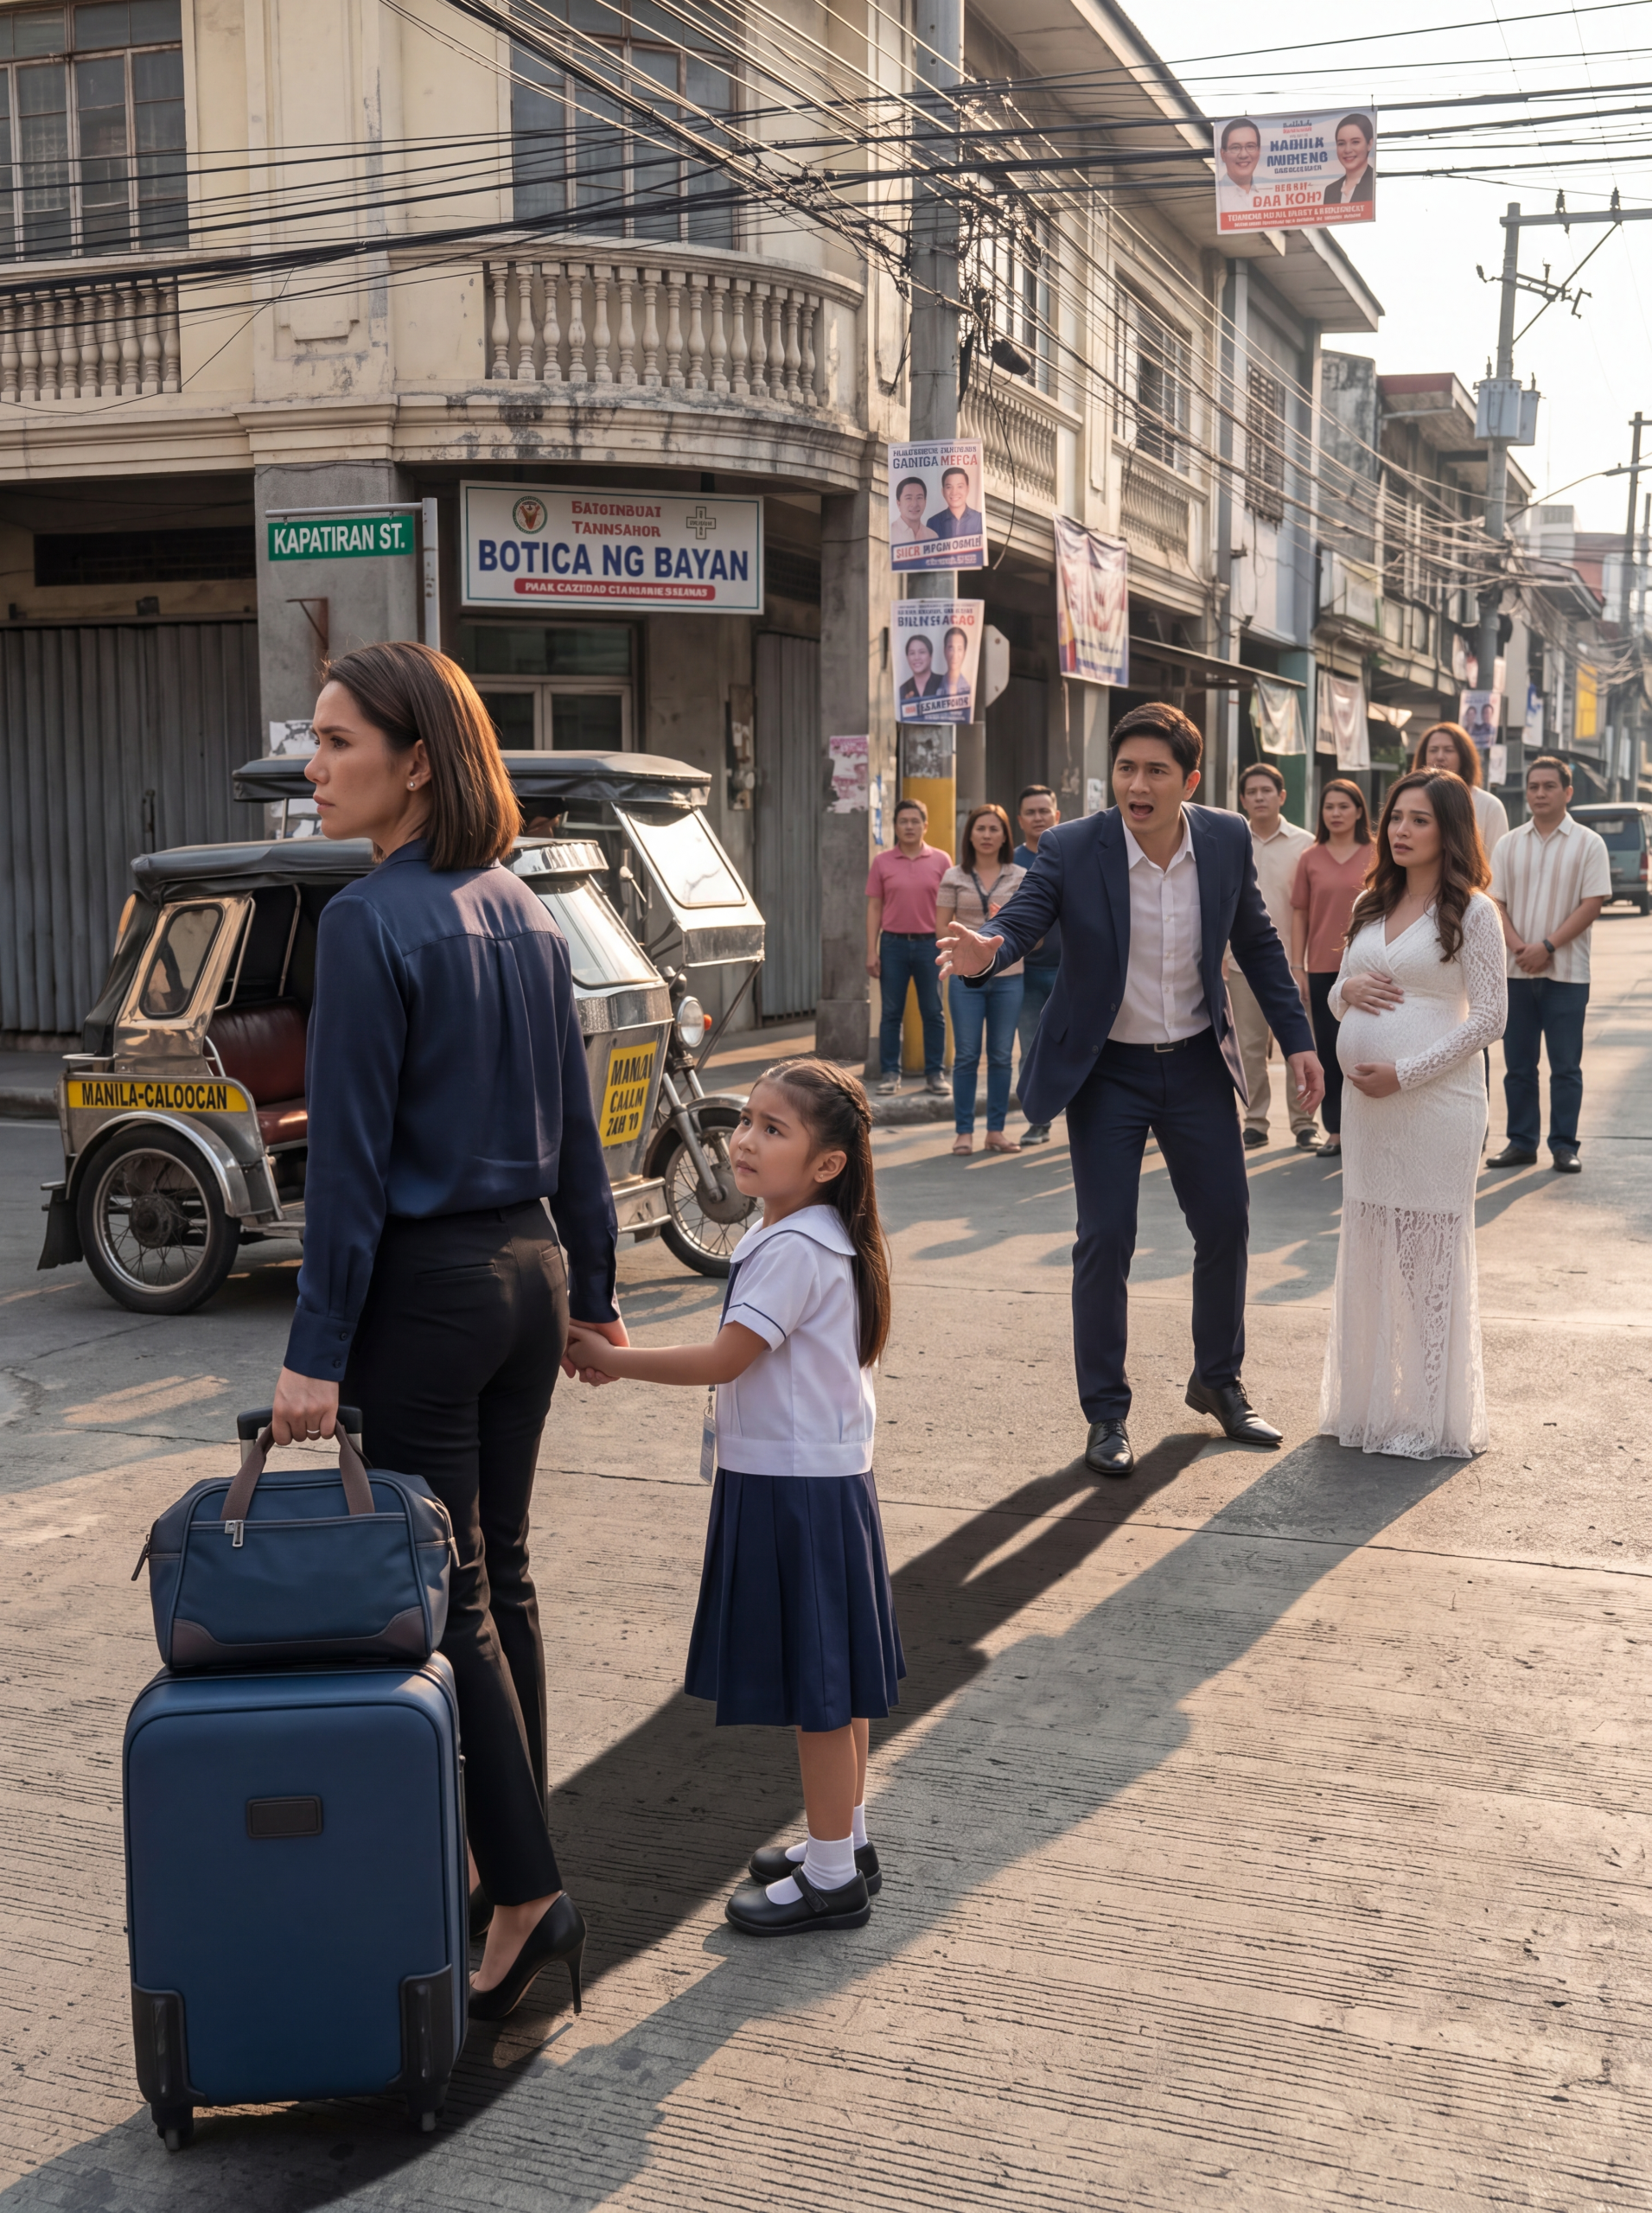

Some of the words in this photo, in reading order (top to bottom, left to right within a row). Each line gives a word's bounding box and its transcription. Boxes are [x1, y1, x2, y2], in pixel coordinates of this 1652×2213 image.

[274, 525, 374, 554] KAPATIRAN
[380, 523, 405, 549] ST.
[479, 539, 593, 575] BOTICA
[603, 545, 644, 577] NG
[654, 546, 748, 581] BAYAN
[81, 1082, 227, 1109] MANILA-CALOOCAN
